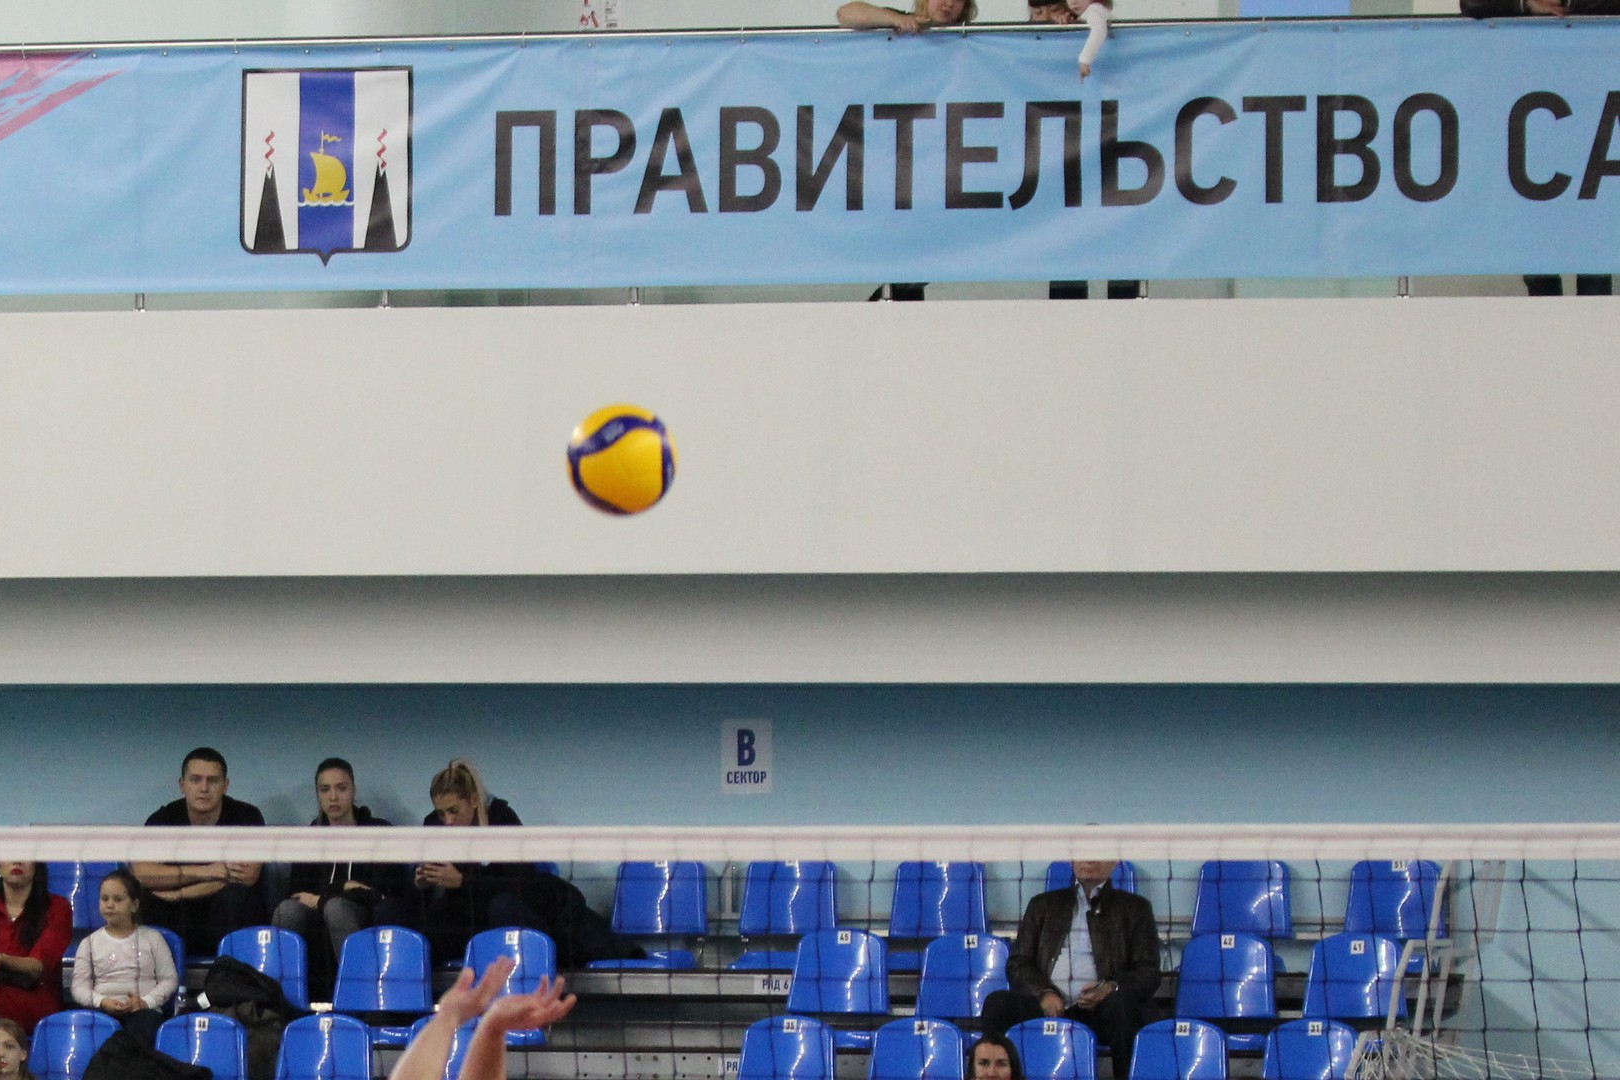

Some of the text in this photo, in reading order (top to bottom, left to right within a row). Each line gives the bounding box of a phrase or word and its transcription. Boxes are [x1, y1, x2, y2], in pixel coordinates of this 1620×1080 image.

[494, 92, 1459, 216] ПРАВИТЕЛЬСТВО
[738, 729, 756, 766] В
[727, 771, 767, 784] СЕКТОР
[762, 979, 789, 990] РЯД 6
[726, 1061, 738, 1071] РЯ
